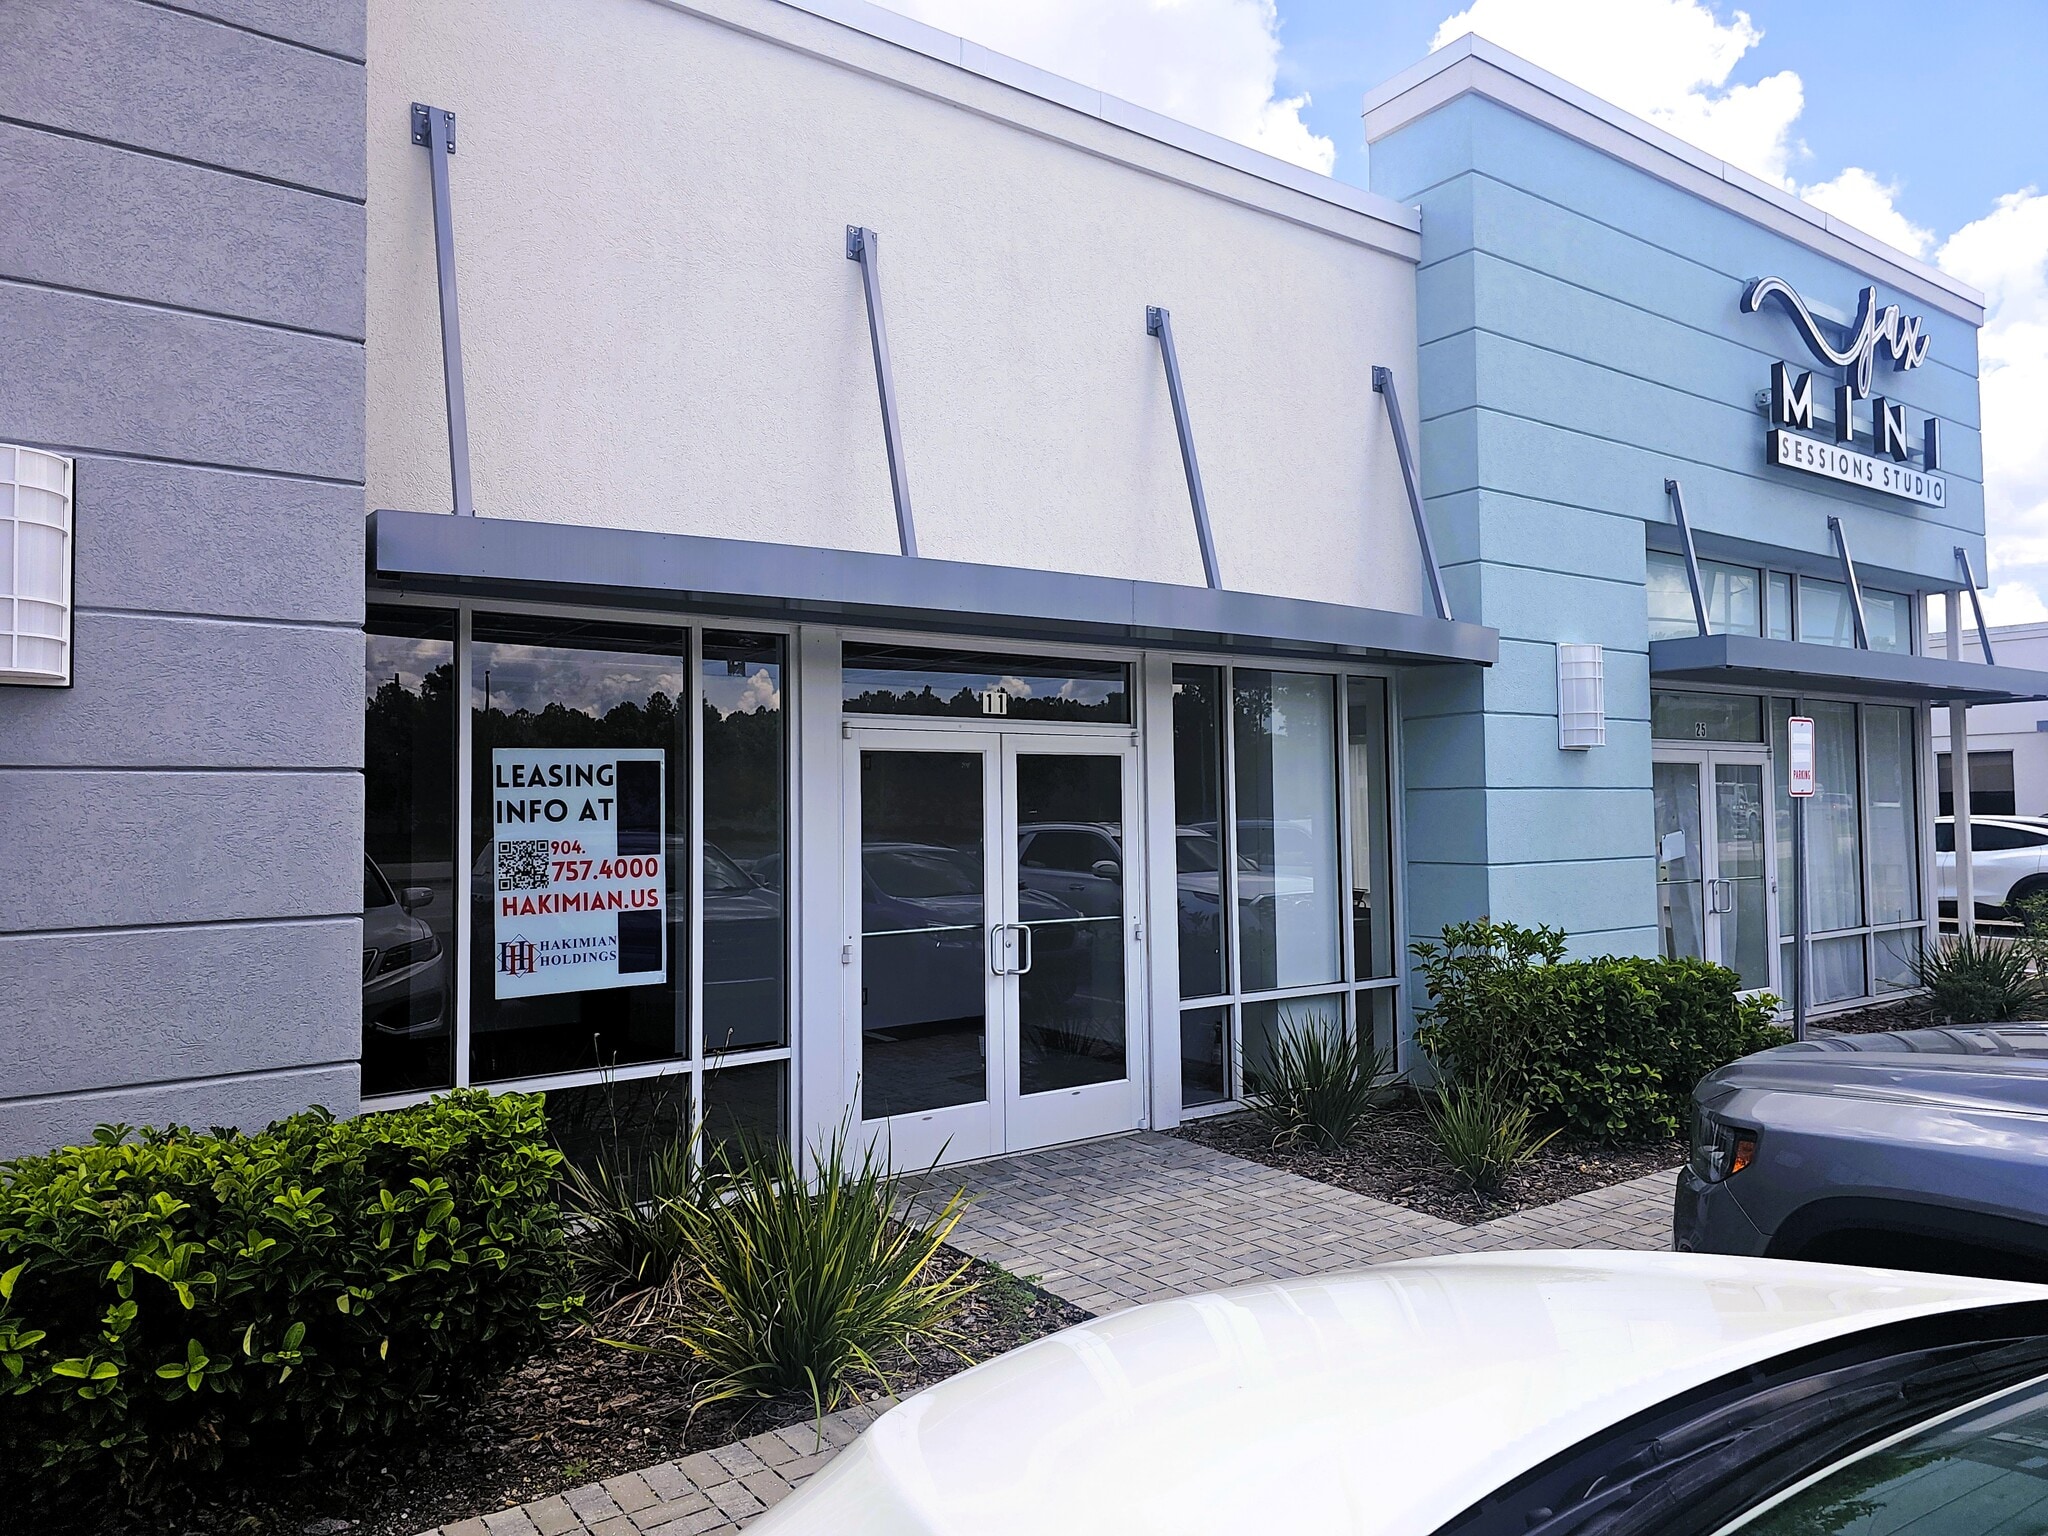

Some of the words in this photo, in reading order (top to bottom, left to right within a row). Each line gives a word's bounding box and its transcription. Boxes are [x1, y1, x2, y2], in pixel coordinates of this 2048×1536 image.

[1771, 361, 1941, 472] MINI
[1782, 437, 1873, 482] SESSIONS
[1883, 469, 1942, 501] STUDIO
[986, 693, 1003, 714] 11
[1695, 722, 1706, 737] 25
[495, 764, 614, 788] LEASING
[1793, 769, 1811, 780] PARKING
[496, 799, 568, 823] INFO
[578, 798, 614, 822] AT
[550, 840, 586, 855] 904.
[551, 857, 658, 882] 757.4000
[502, 889, 659, 917] HAKIMIAN.US
[540, 935, 617, 951] HAKIMIAN
[540, 950, 617, 967] HOLDINGS
